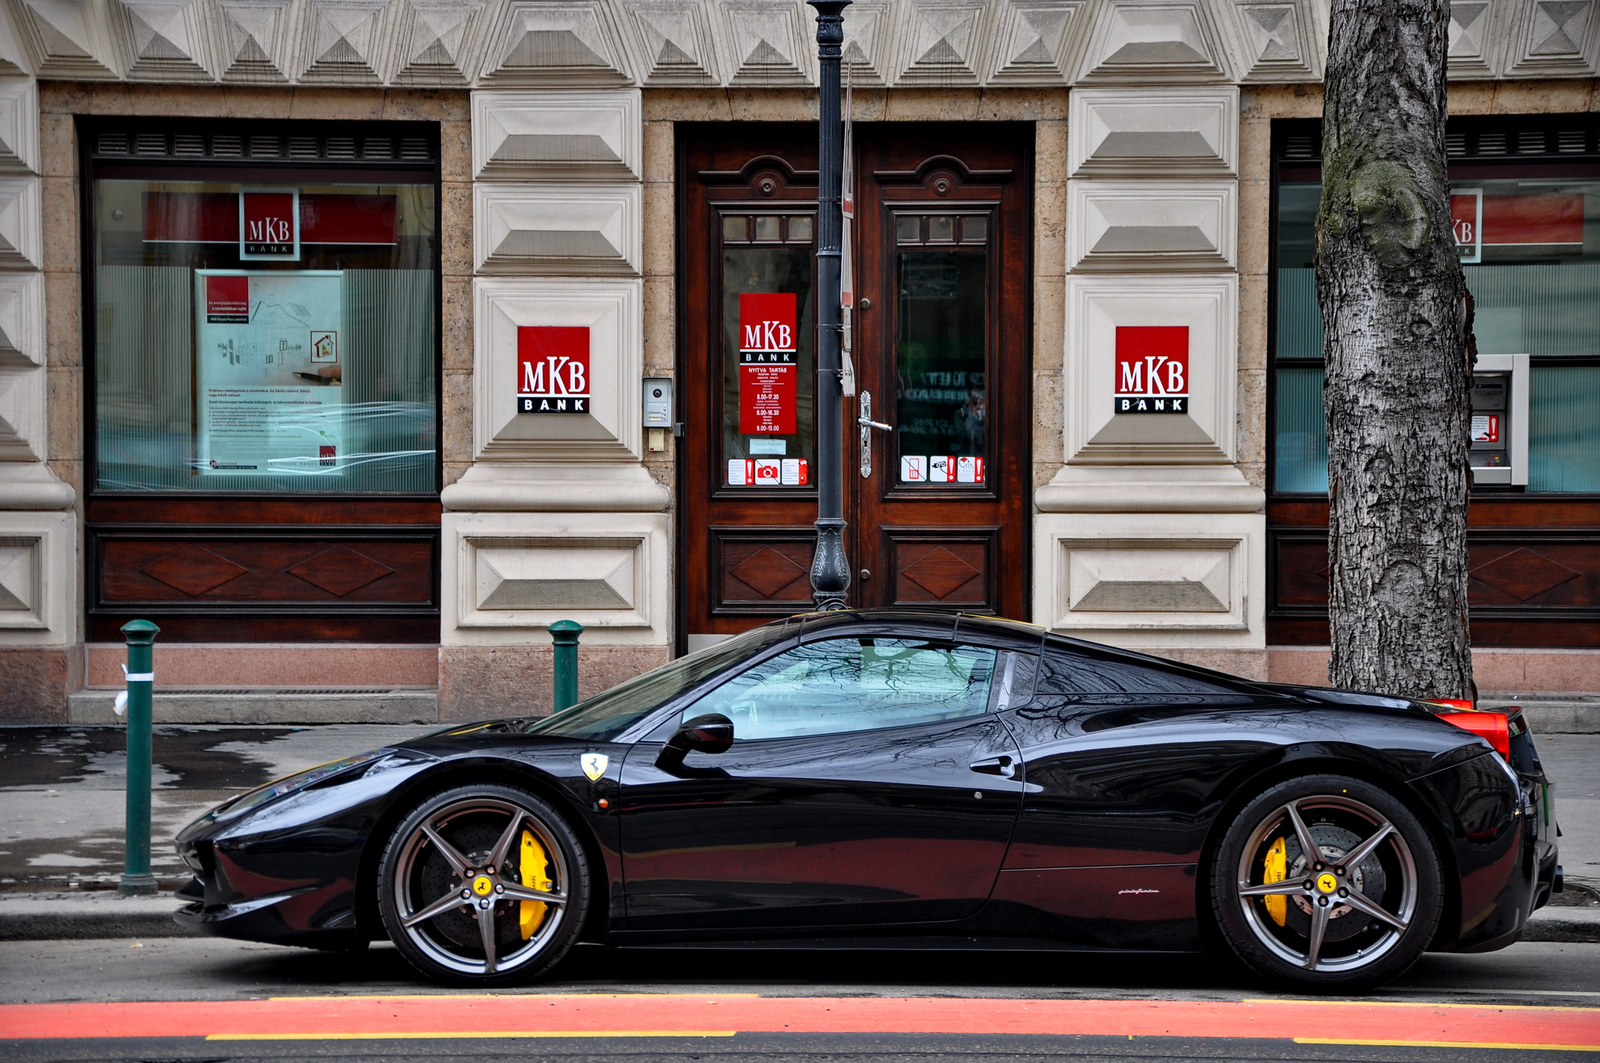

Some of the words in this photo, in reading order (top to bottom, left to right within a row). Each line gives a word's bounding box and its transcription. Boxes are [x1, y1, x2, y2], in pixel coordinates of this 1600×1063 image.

[249, 217, 290, 243] MKB
[1451, 219, 1472, 246] KB
[249, 245, 288, 253] BANK
[744, 320, 792, 350] MKB
[745, 353, 790, 362] BANK
[522, 356, 586, 395] MKB
[1120, 355, 1184, 395] MKB
[524, 399, 584, 411] BANK
[1121, 399, 1182, 411] BANK
